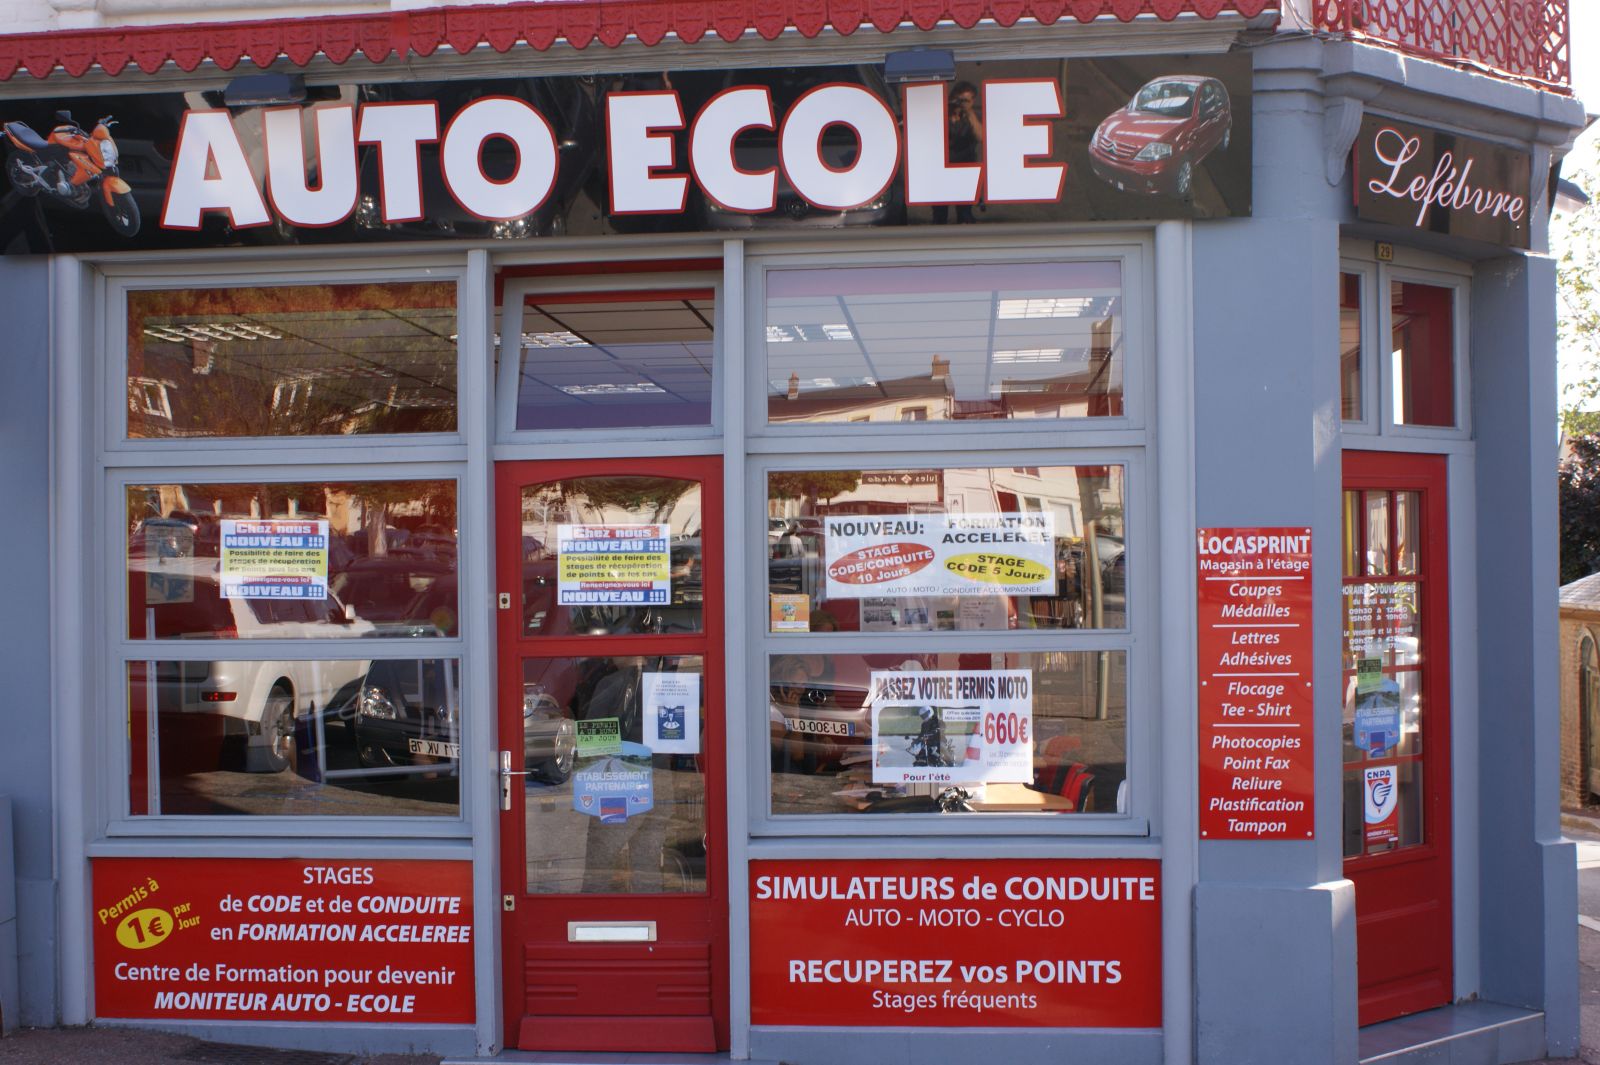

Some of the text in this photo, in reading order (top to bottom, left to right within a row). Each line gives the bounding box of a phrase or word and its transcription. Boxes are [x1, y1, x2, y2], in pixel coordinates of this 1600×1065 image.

[159, 77, 1068, 230] AUTO ECOLE
[1369, 127, 1524, 226] Lefébvre
[1380, 246, 1391, 258] 29
[237, 523, 311, 534] Chez nous
[575, 528, 651, 538] Chez nous
[830, 517, 1046, 537] NOUVEAU: FORMATION
[225, 536, 323, 547] NOUVEAU !!!
[942, 532, 1050, 544] ACCELEREE
[1199, 536, 1310, 554] LOCASPRINT
[562, 541, 664, 552] NOUVEAU !!!
[857, 544, 900, 560] STAGE
[270, 557, 321, 566] récupération
[566, 563, 594, 571] stages
[609, 562, 662, 571] récupération
[828, 550, 934, 578] CODE/CONDUITE
[977, 554, 1026, 569] STAGE
[1200, 559, 1310, 574] Magasin à l'étage
[579, 571, 605, 579] points
[857, 567, 911, 584] 10 Jours
[946, 562, 1045, 582] CODE 5 Jours
[225, 586, 322, 596] NOUVEAU !!!
[563, 591, 664, 602] NOUVEAU !!!
[1230, 583, 1282, 599] Coupes
[1221, 604, 1290, 617] Médailles
[1231, 632, 1280, 645] Lettres
[1219, 652, 1292, 666] Adhésives
[876, 676, 1028, 700] PASSEZ VOTRE PERMIS MOTO
[1228, 682, 1284, 698] Flocage
[1222, 703, 1245, 716] Tee
[1256, 703, 1292, 716] Shirt
[984, 712, 1028, 744] 660€
[1212, 735, 1301, 751] Photocopies
[1223, 756, 1290, 770] Point Fax
[576, 771, 649, 781] ETABLISSEMENT
[1367, 770, 1392, 779] CNPA
[1232, 777, 1282, 790] Reliure
[1209, 797, 1304, 811] Plastification
[1228, 819, 1287, 835] Tampon
[303, 867, 373, 885] STAGES
[756, 876, 1155, 901] SIMULATEURS de CONDUITE
[98, 877, 159, 925] Permis à
[219, 895, 461, 914] de CODE et de CONDUITE
[173, 902, 191, 918] par
[844, 909, 901, 927] AUTO
[919, 909, 981, 927] MOTO
[998, 909, 1065, 927] CYCLO
[127, 916, 165, 943] 1€
[178, 915, 201, 930] Jour
[210, 924, 471, 943] en FORMATION ACCELEREE
[114, 963, 455, 987] Centre de Formation pour devenir
[789, 960, 1122, 984] RECUPEREZ vos POINTS
[154, 992, 267, 1011] MONITEUR
[271, 993, 330, 1012] AUTO
[346, 994, 415, 1013] ECOLE
[872, 990, 1038, 1013] Stages fréquents
